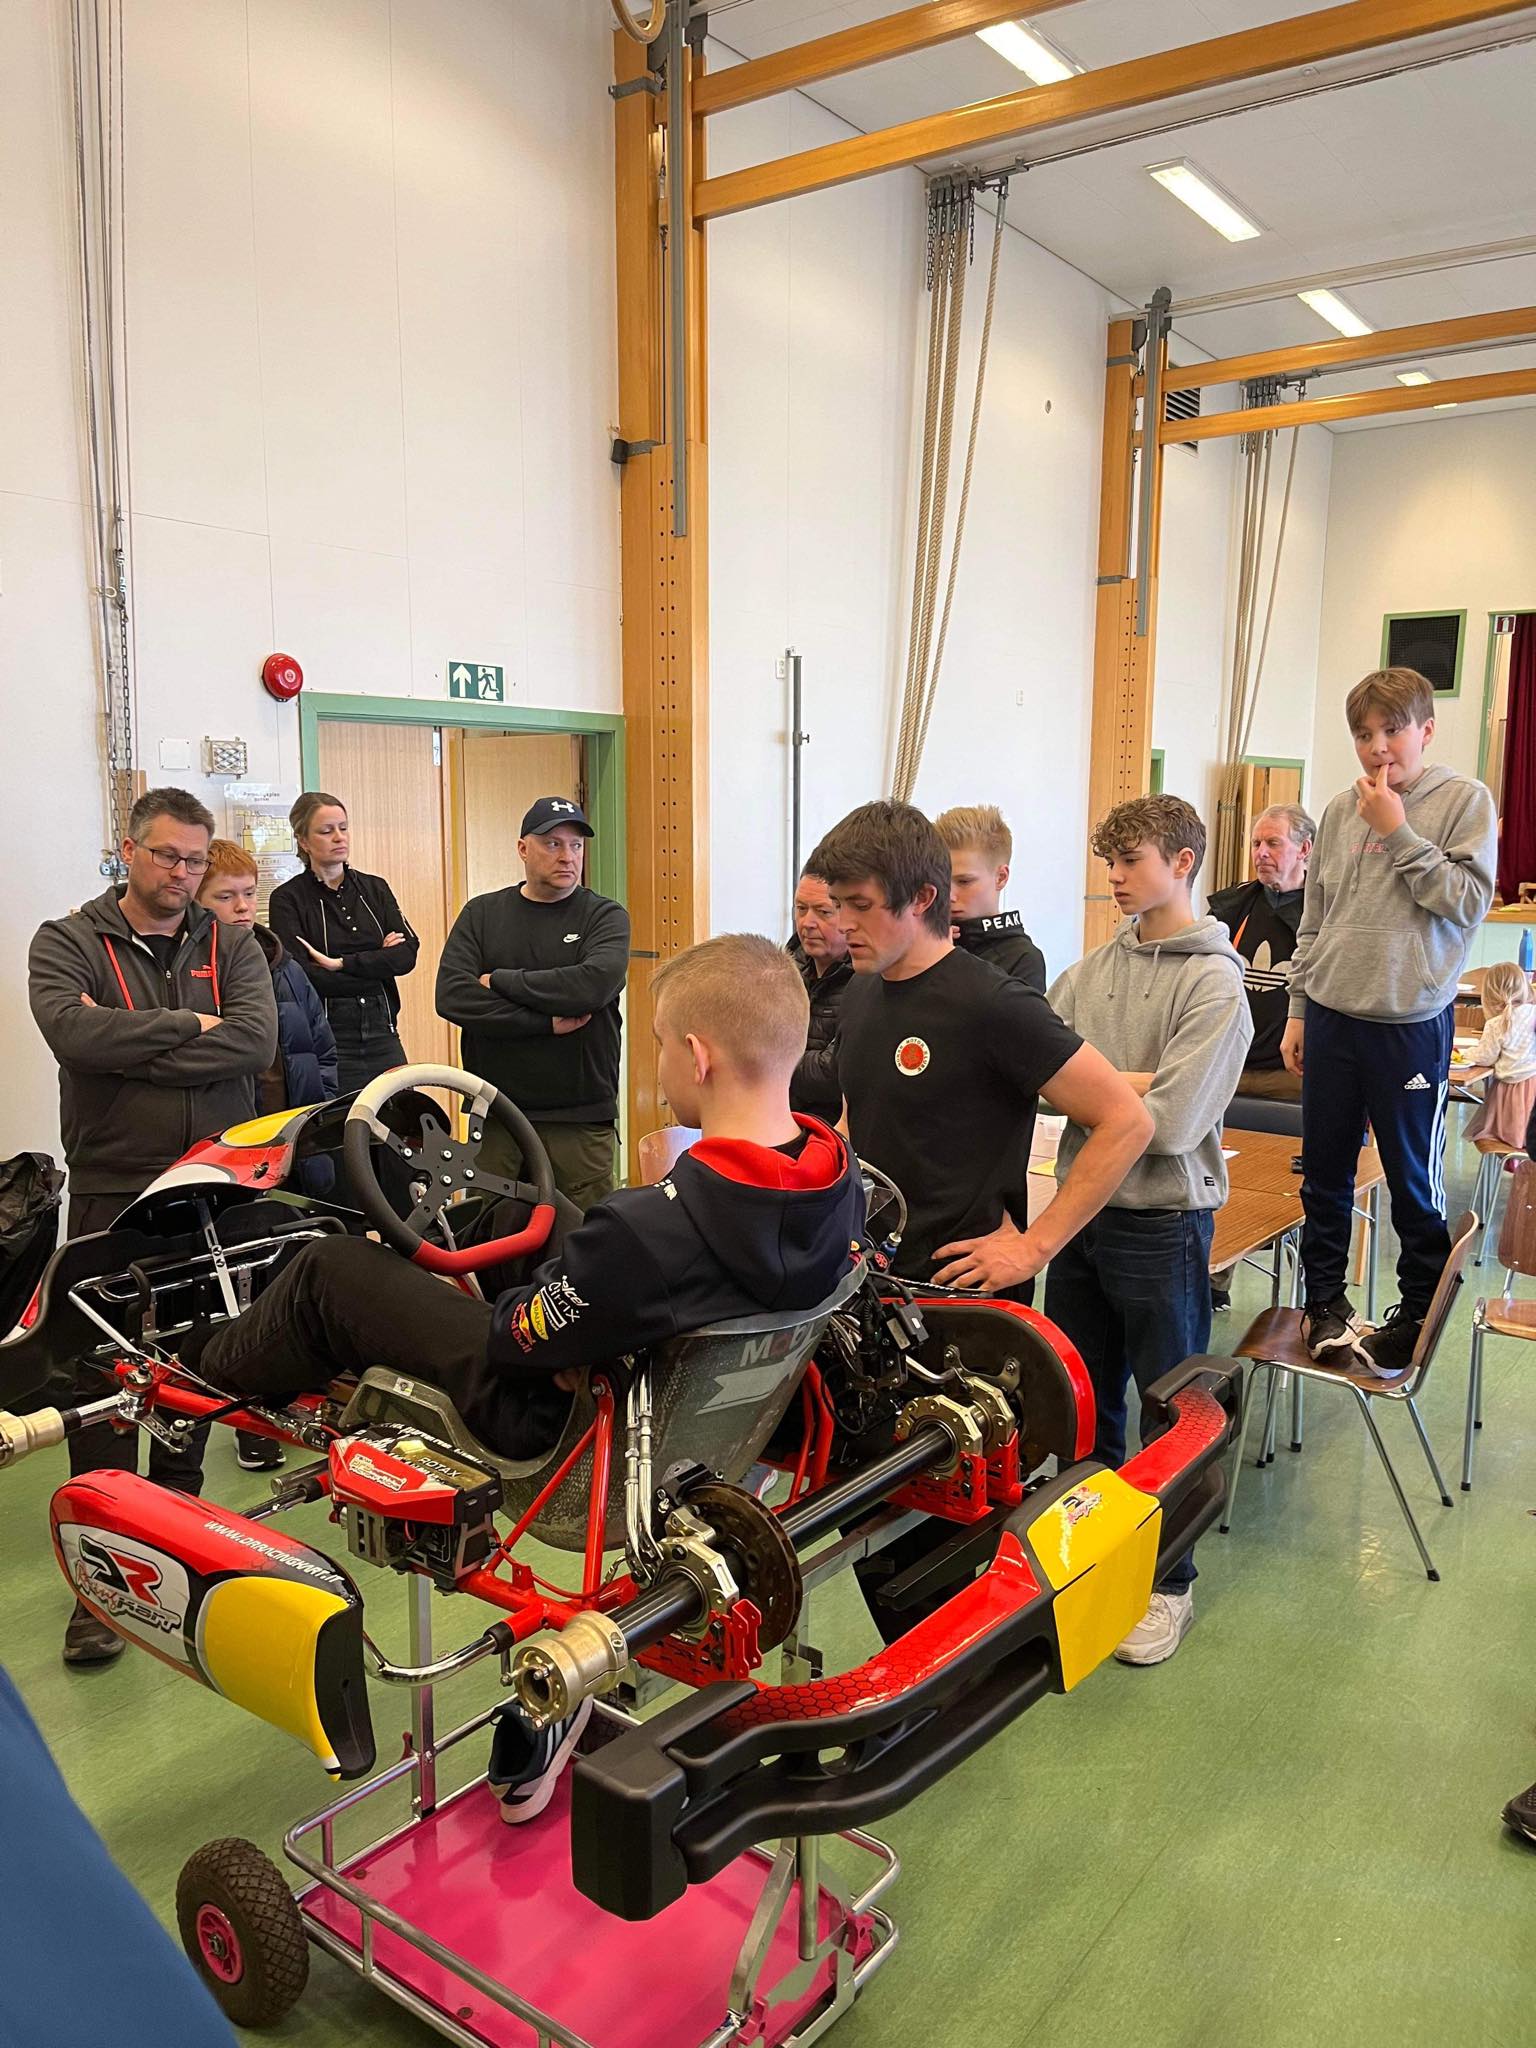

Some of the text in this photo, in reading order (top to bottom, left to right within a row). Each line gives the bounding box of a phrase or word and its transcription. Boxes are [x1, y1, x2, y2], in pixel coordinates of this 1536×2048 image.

[982, 912, 1020, 932] PEAK
[418, 1456, 462, 1479] ROTAX
[203, 1519, 345, 1585] WWW.DRRACINGKART.IT
